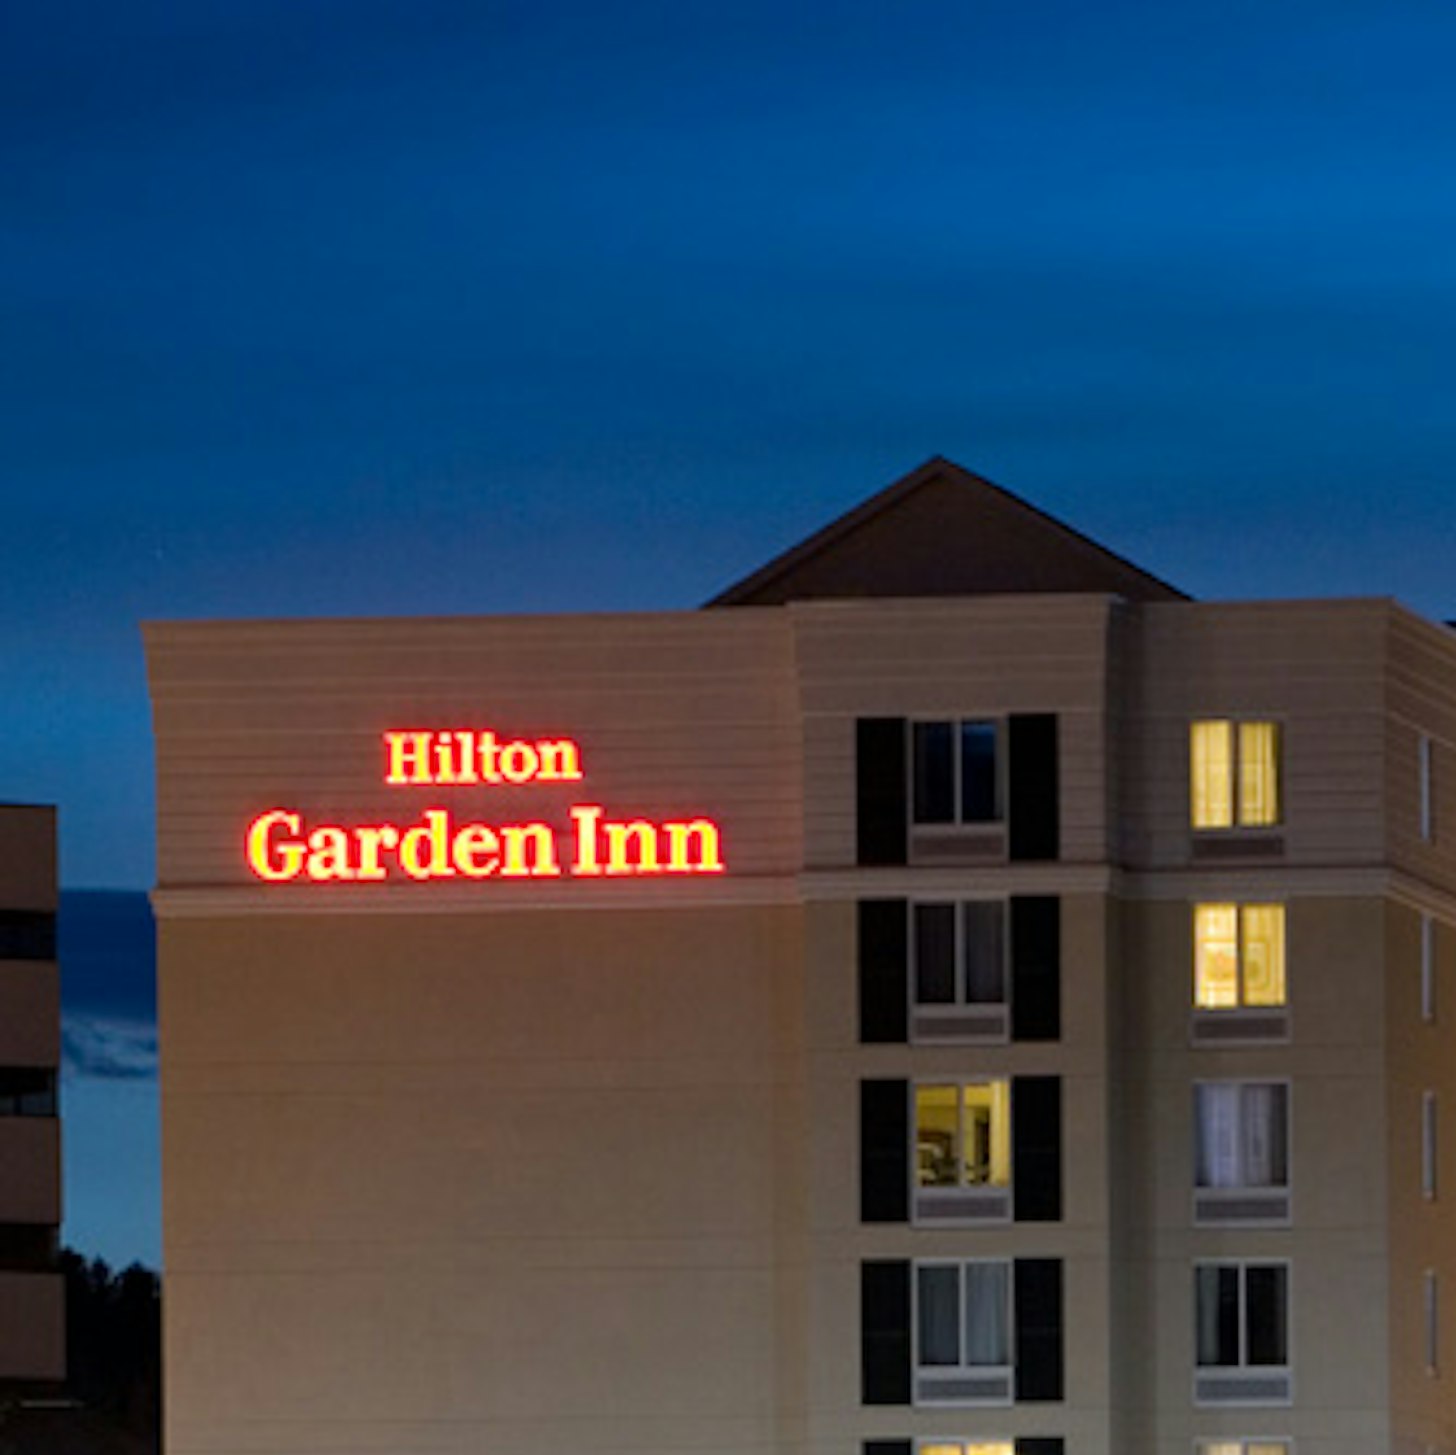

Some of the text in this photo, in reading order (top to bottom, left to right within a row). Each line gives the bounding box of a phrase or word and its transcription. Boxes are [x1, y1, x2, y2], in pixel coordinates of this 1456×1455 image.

[384, 729, 583, 786] Hilton
[246, 803, 726, 882] Garden Inn
